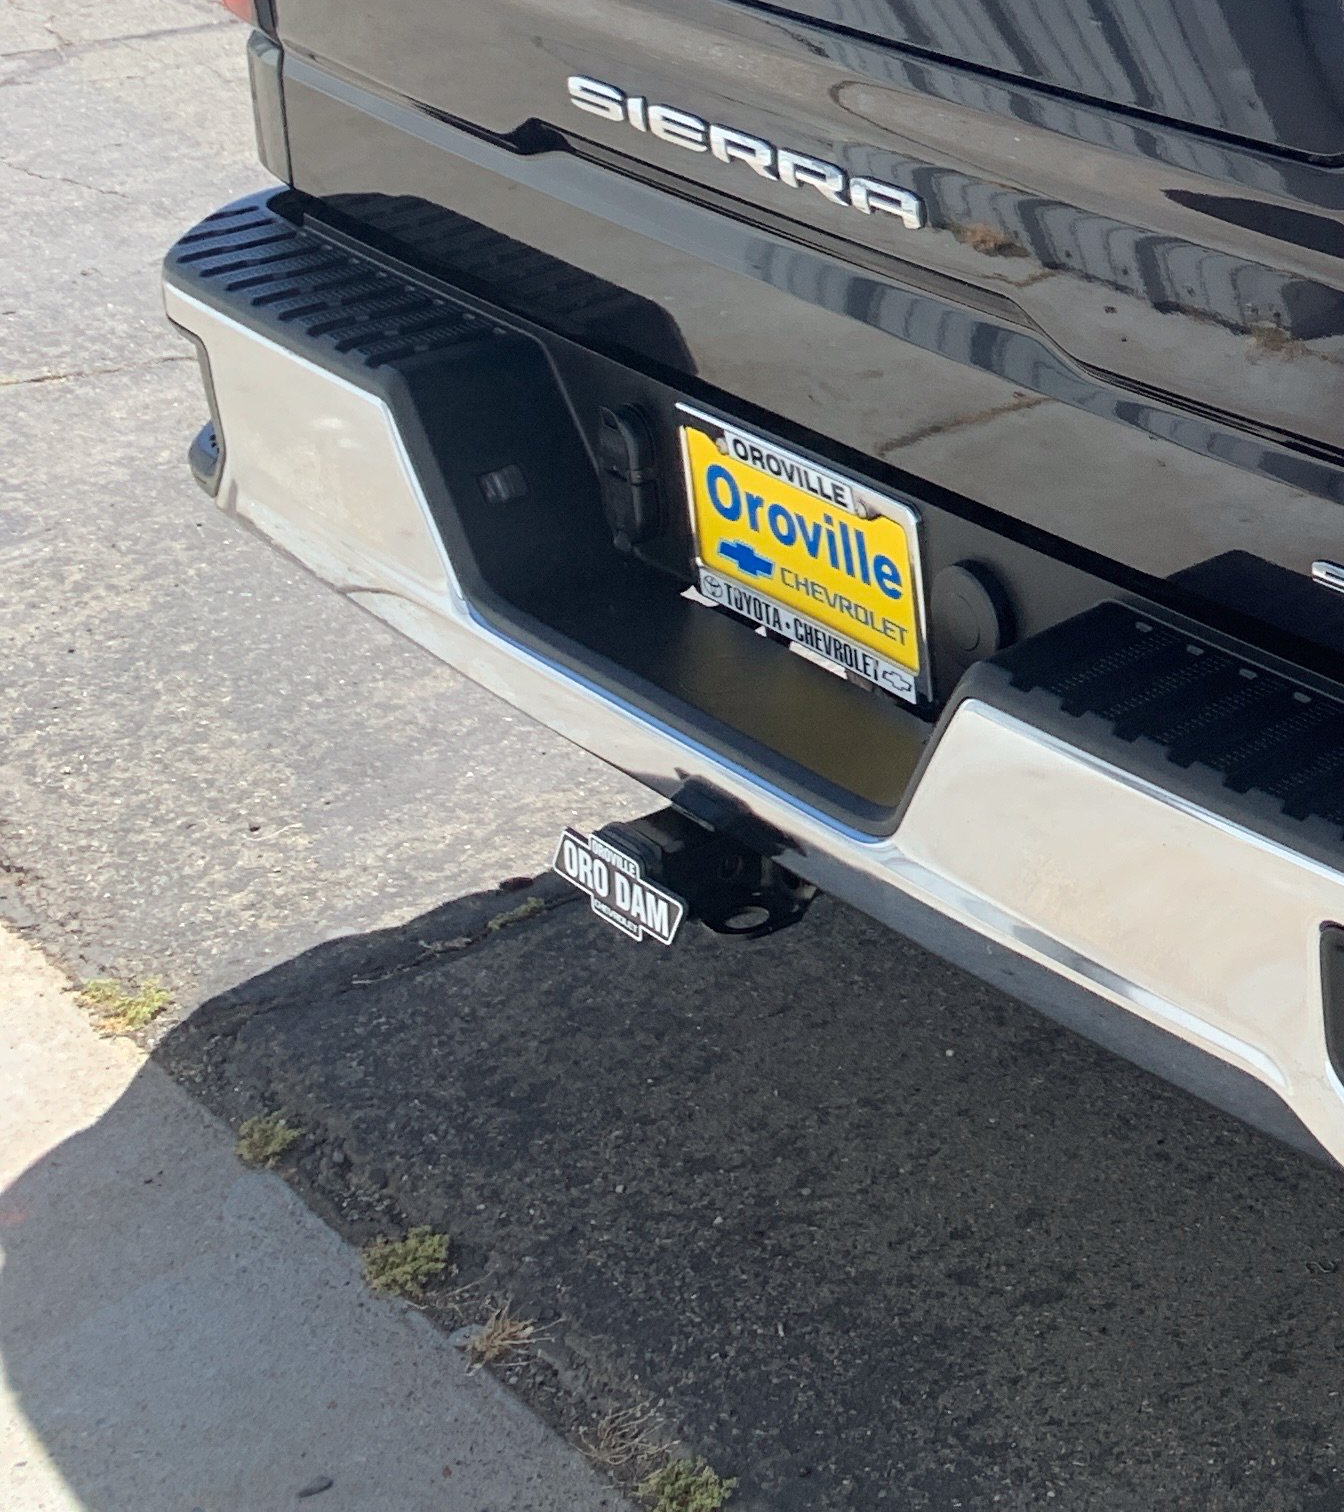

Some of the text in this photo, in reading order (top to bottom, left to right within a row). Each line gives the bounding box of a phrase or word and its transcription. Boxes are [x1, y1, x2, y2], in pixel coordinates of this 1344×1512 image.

[567, 74, 928, 230] SIERRA
[732, 439, 849, 509] OROVILLE
[706, 463, 903, 600] Oroville
[723, 582, 879, 682] TOYOTA CHEVROLET
[780, 567, 909, 646] CHEVROLET
[563, 839, 670, 938] ORO DAM
[591, 838, 637, 874] OROVILLE
